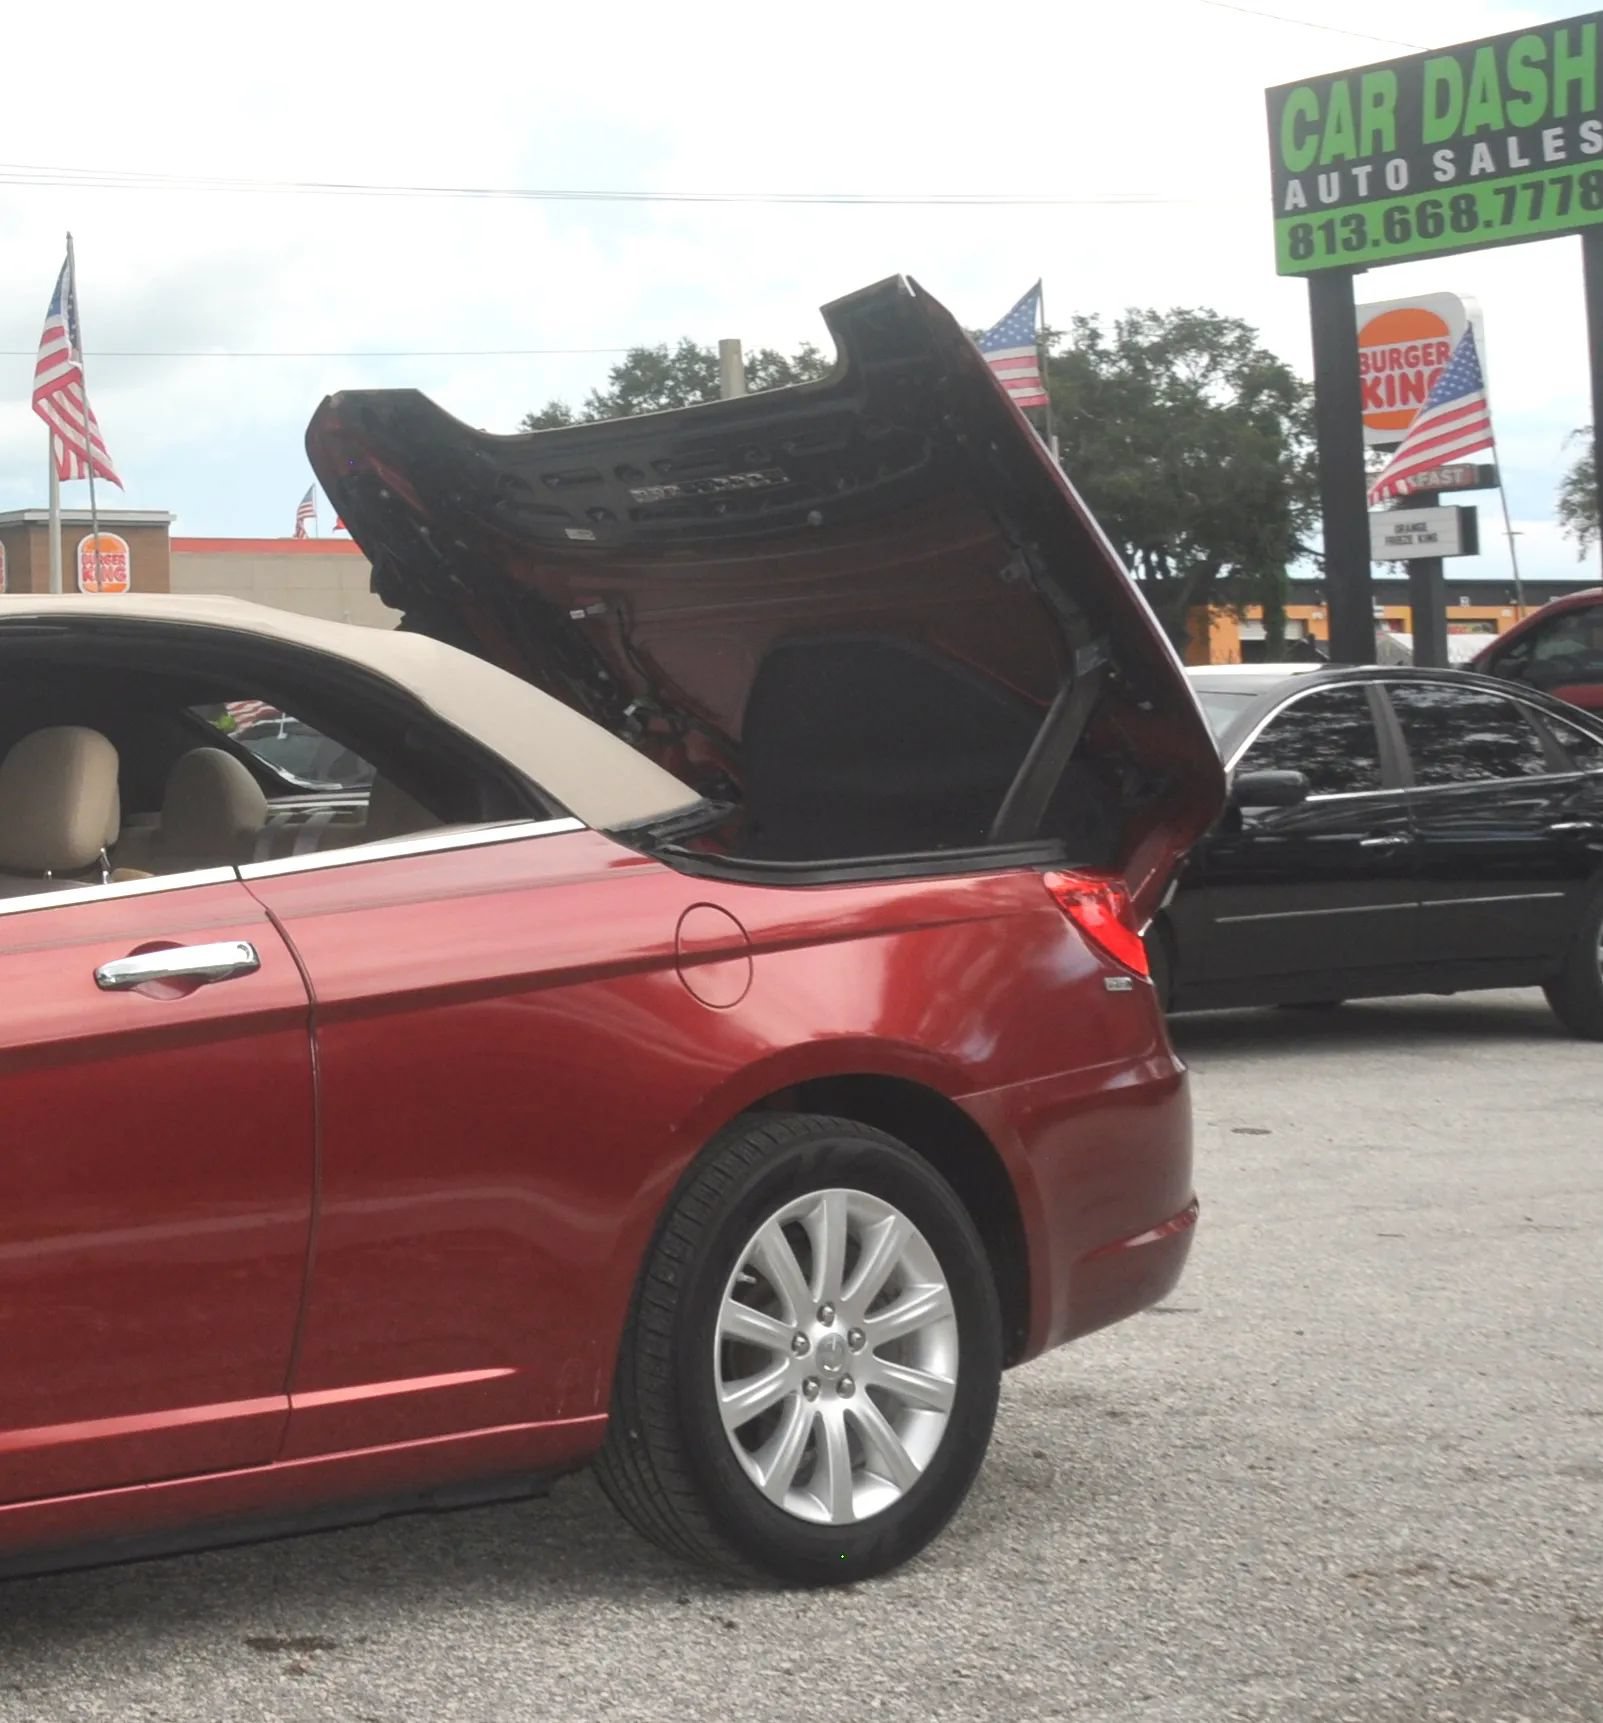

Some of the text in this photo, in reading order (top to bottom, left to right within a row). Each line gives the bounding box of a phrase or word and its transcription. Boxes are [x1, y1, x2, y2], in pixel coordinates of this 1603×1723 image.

[1280, 22, 1597, 173] CAR DASH
[1284, 119, 1603, 211] AUTO SALES
[1287, 169, 1603, 261] 813.668.7778
[1359, 341, 1450, 375] BURGER
[82, 566, 127, 582] KNG
